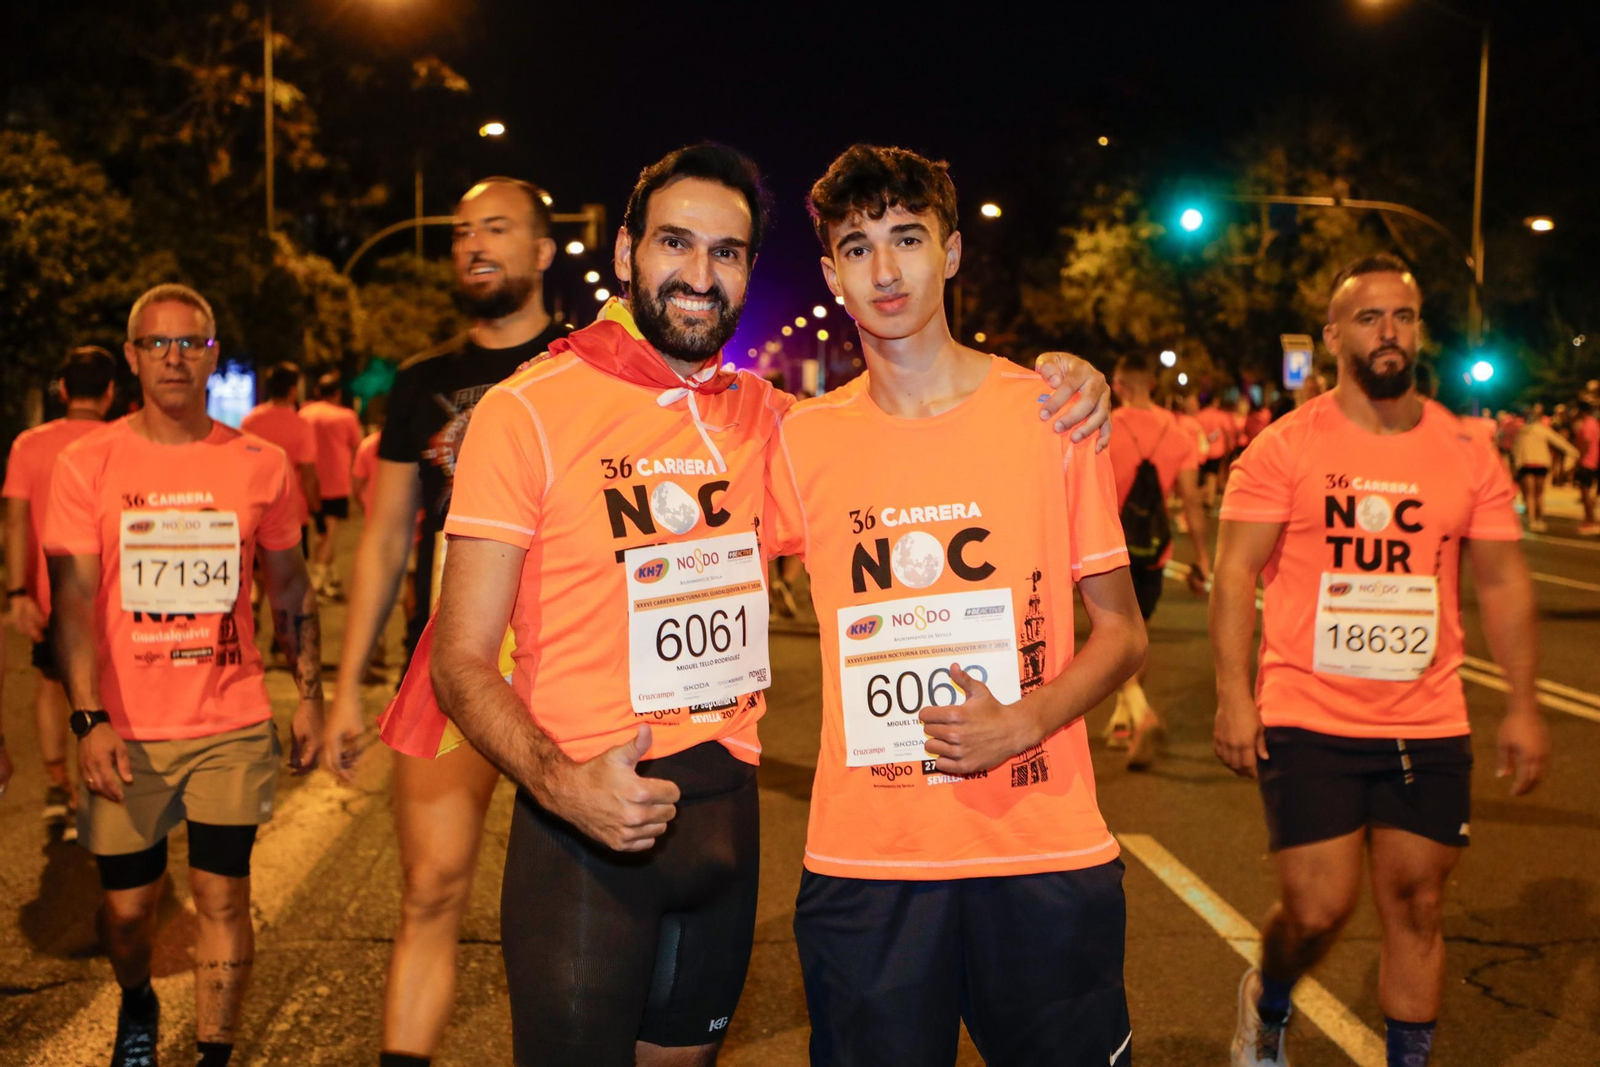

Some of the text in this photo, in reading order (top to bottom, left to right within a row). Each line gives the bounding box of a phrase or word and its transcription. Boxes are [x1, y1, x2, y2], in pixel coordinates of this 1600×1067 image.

[601, 455, 716, 479] 36 CARRERA
[1325, 474, 1418, 494] 36 CARRERA
[122, 492, 214, 509] 36 CARRERA
[849, 502, 982, 534] 36 CARRERA
[1326, 536, 1411, 574] TUR
[132, 560, 230, 586] 17134
[656, 605, 747, 661] 6061
[1326, 624, 1429, 654] 18632
[864, 654, 887, 662] CARRERA
[888, 650, 918, 658] NOCTURNA
[931, 645, 976, 654] GUADALQUIVIR
[699, 660, 714, 668] TELLO
[748, 668, 767, 678] POWER
[638, 691, 675, 701] Cruzcampo
[691, 712, 722, 724] SEVILLA
[853, 747, 885, 756] Cruzcampo
[927, 770, 988, 785] SEVILLA 2024
